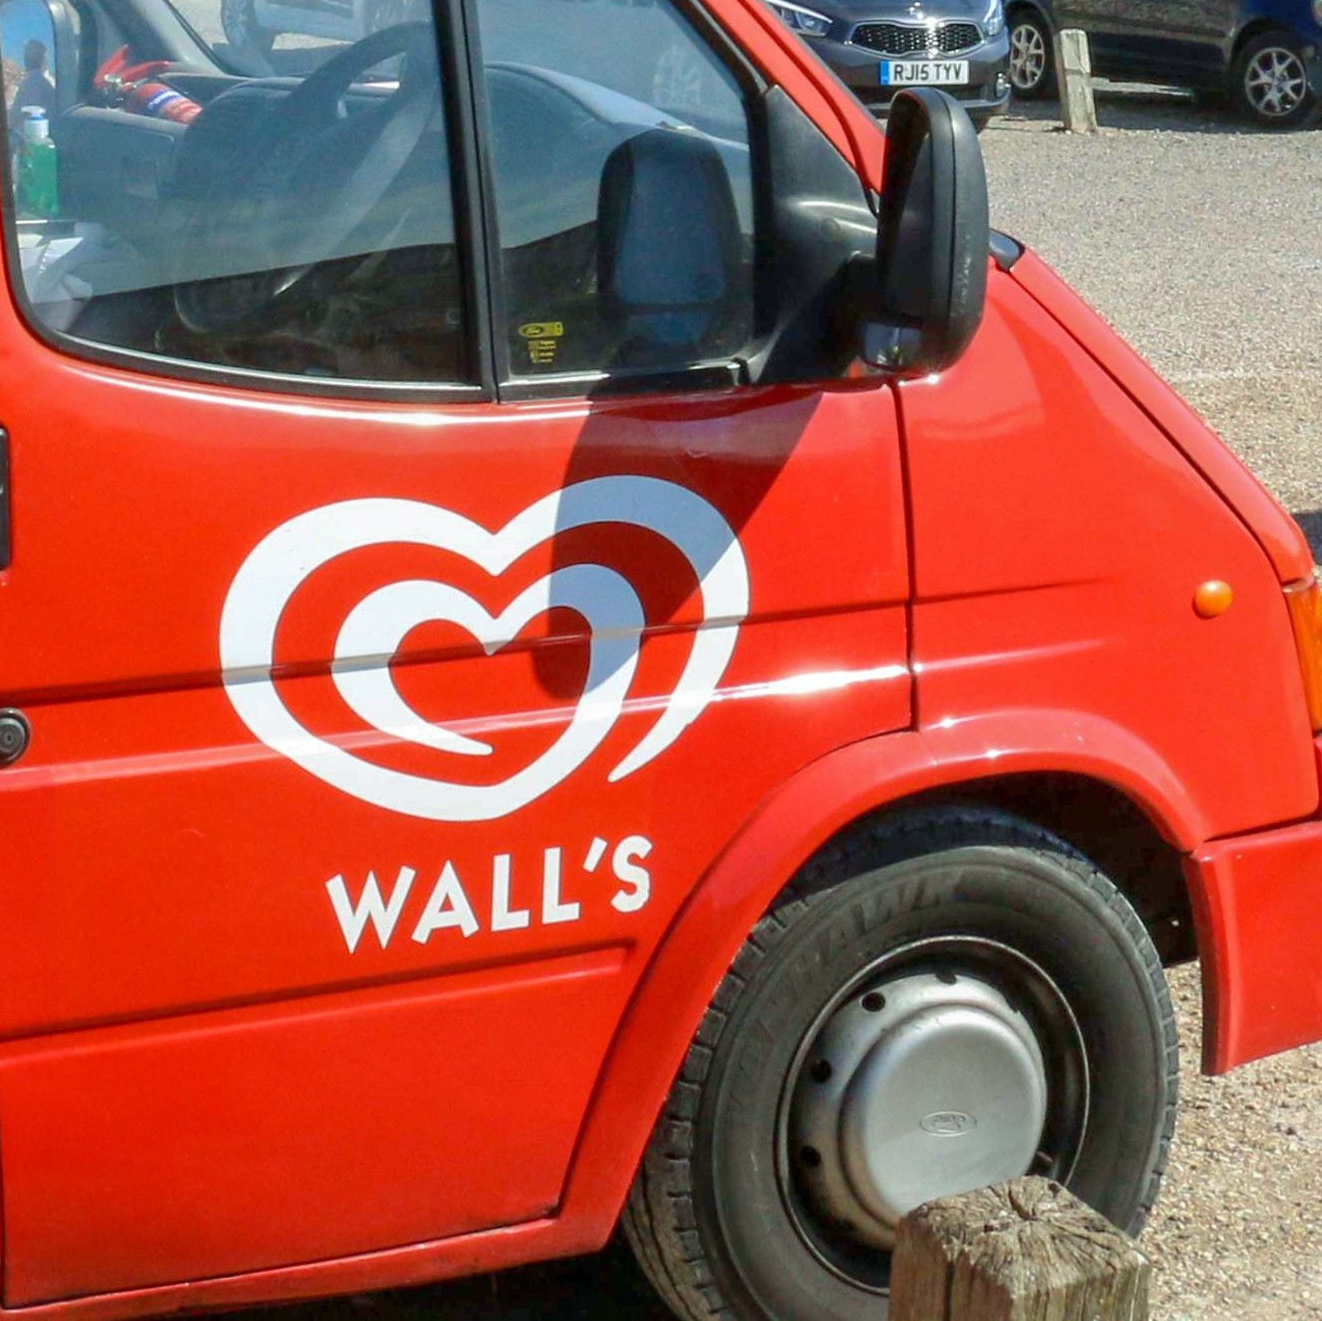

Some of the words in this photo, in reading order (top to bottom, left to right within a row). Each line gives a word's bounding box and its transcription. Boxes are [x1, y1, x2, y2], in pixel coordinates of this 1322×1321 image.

[893, 64, 930, 81] RJ15
[933, 63, 963, 81] TYV
[325, 834, 654, 955] WALL'S
